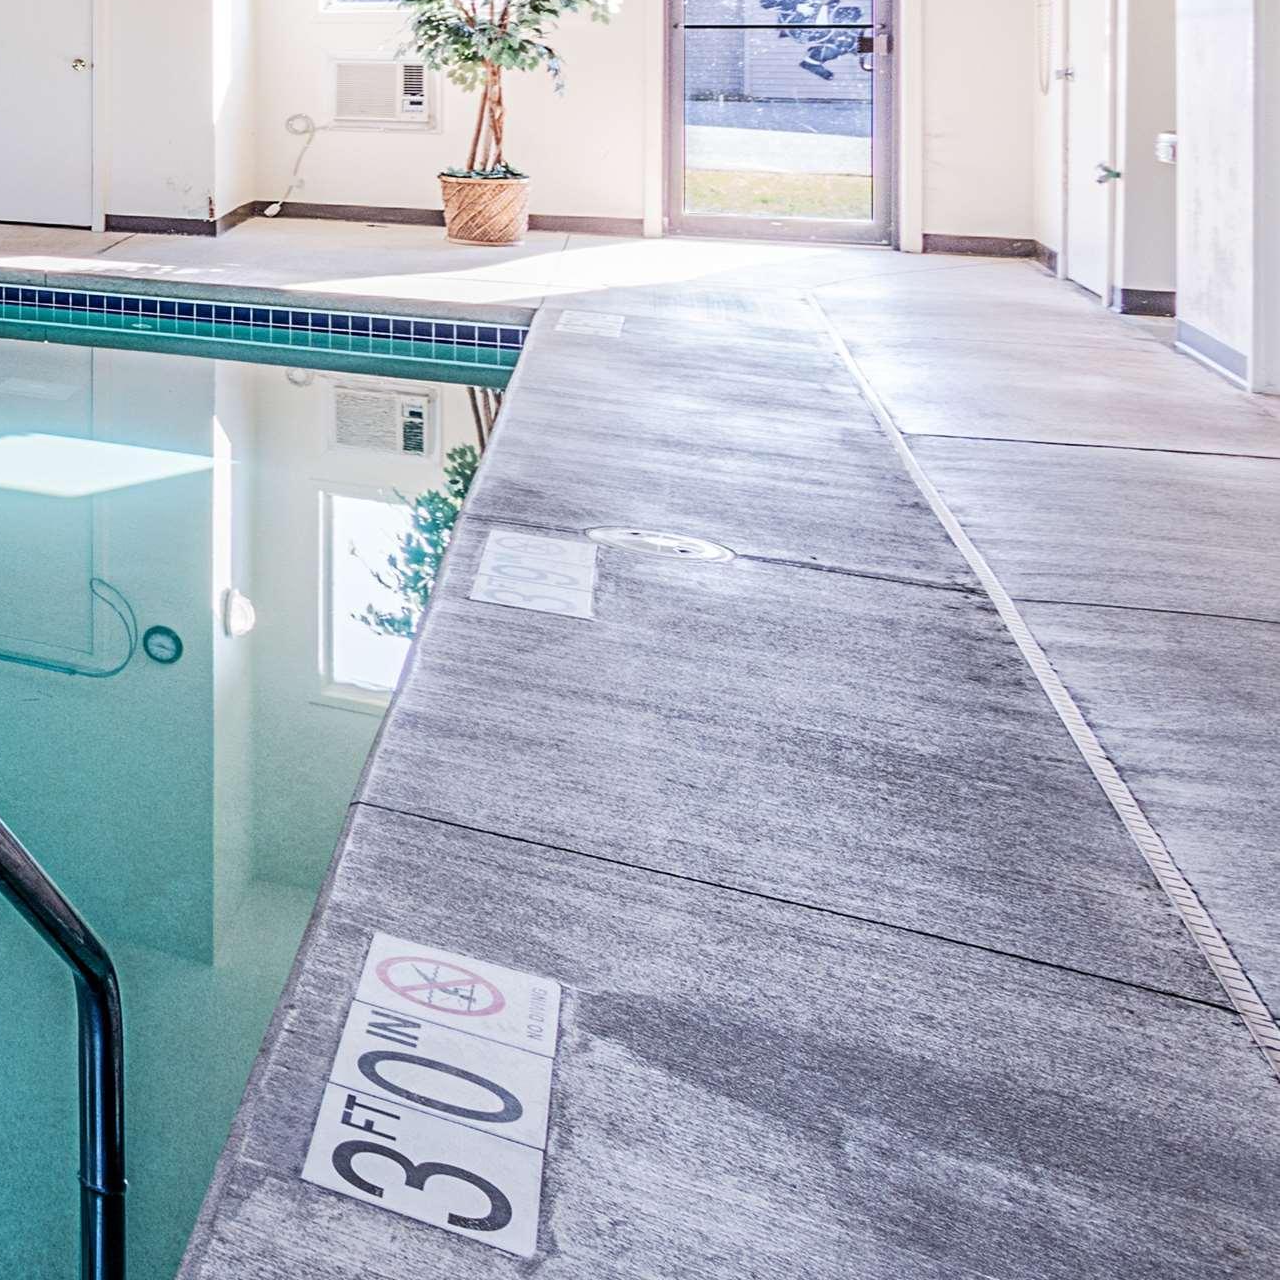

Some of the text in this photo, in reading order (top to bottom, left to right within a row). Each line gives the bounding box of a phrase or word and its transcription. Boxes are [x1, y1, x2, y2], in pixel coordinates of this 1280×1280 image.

[365, 1009, 422, 1049] IN
[527, 1023, 544, 1041] NO
[340, 1093, 401, 1141] FT
[331, 1139, 513, 1233] 3
